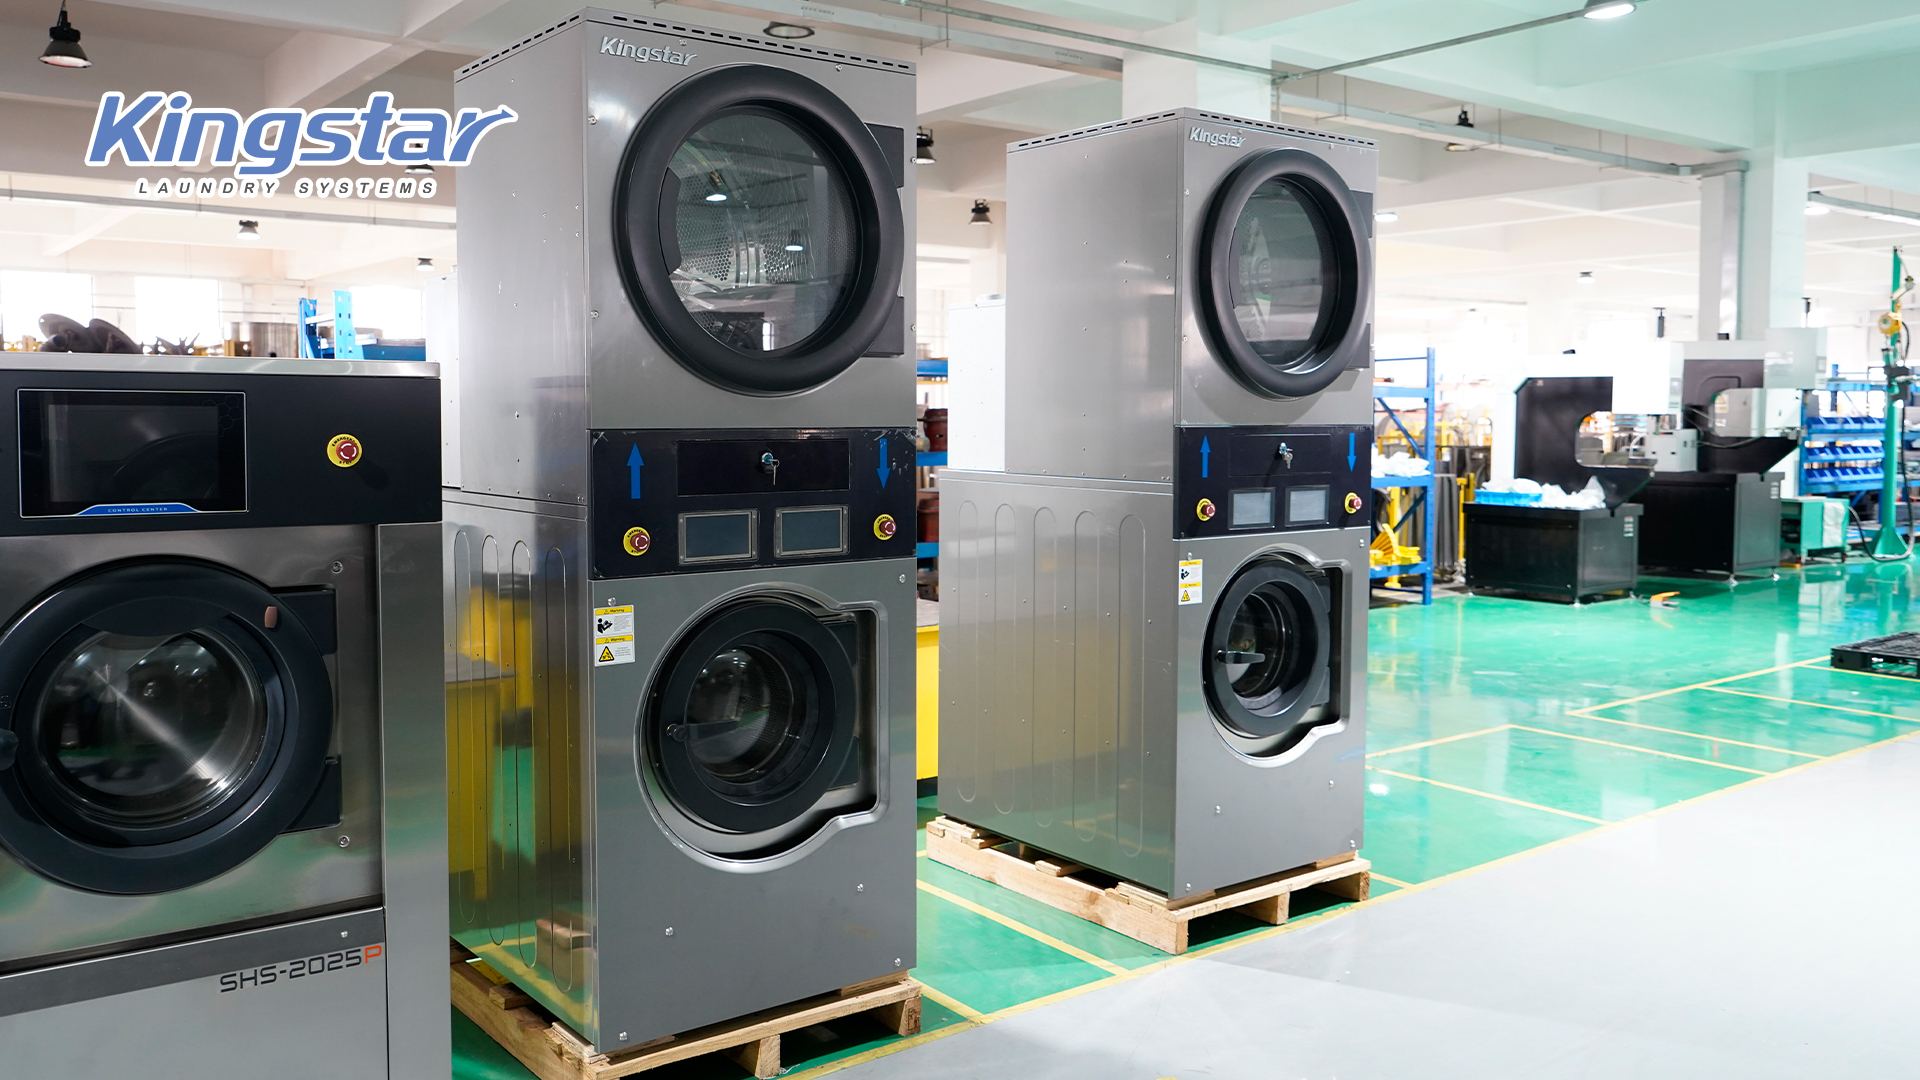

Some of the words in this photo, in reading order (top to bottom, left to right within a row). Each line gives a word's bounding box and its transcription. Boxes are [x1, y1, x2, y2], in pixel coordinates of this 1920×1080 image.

[600, 36, 698, 66] Kingstar
[1189, 126, 1247, 148] Kingstar
[220, 945, 382, 993] SHS-2025P
